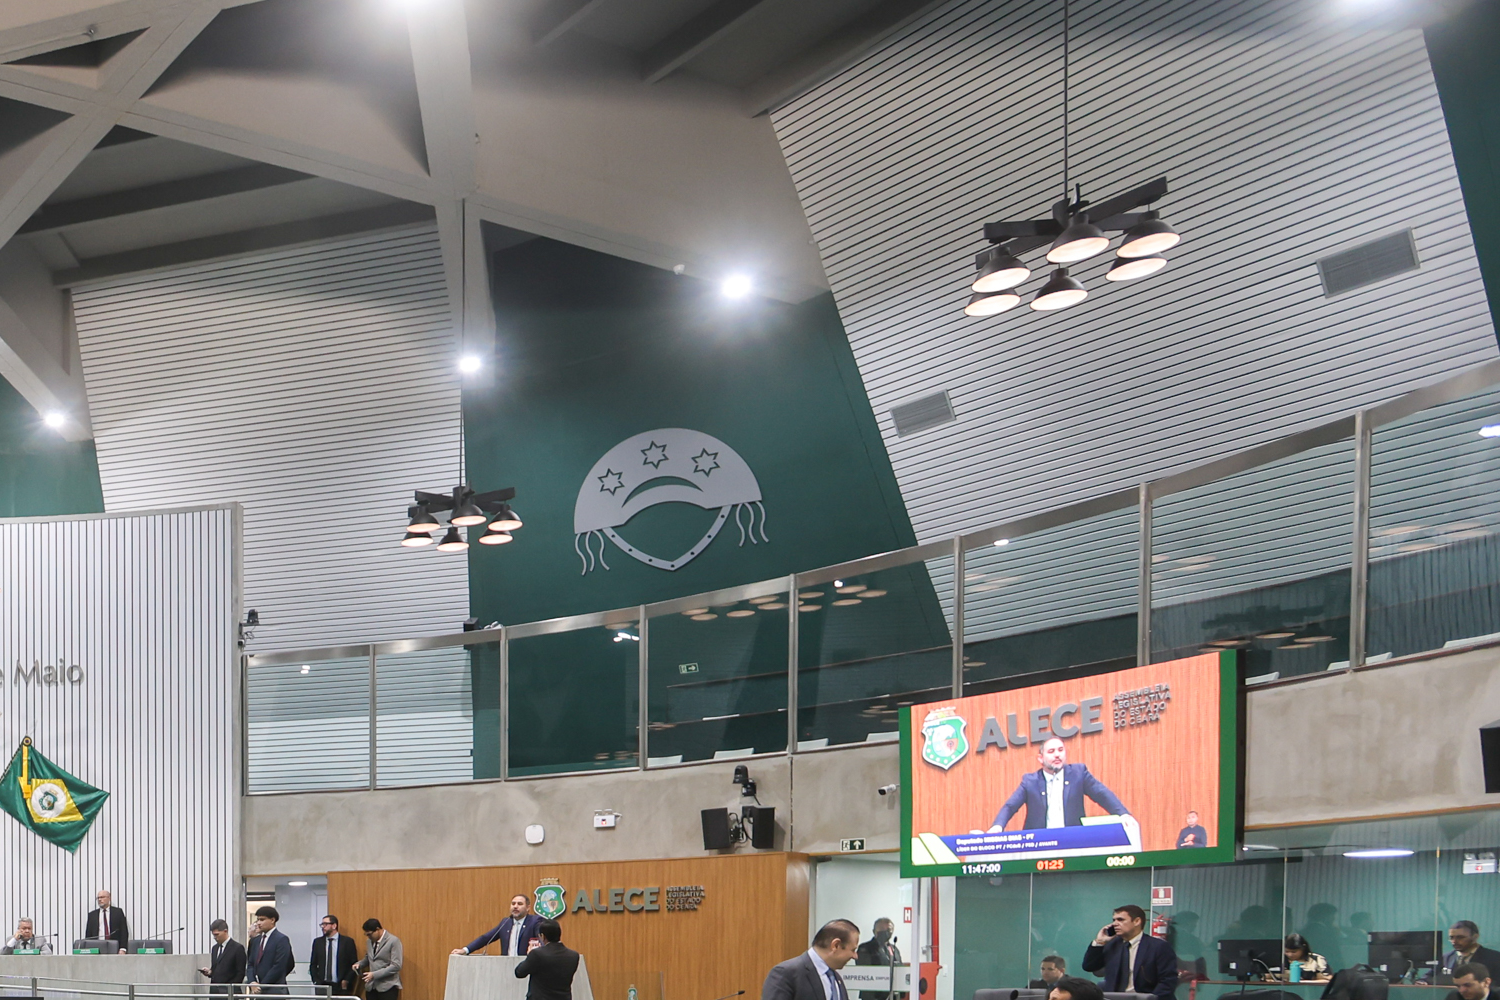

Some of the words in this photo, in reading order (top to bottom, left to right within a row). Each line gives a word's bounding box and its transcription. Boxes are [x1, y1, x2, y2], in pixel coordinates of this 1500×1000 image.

[14, 658, 85, 687] Maio
[1113, 683, 1170, 700] ASSEMBLEIA
[1113, 691, 1171, 710] LEGISLATIVA
[1114, 709, 1126, 719] DO
[1129, 701, 1166, 717] ESTADO
[976, 696, 1104, 753] ALECE
[1114, 718, 1126, 729] DO
[962, 864, 1001, 874] 11:47:00
[1037, 860, 1064, 870] 01:25
[1106, 855, 1135, 867] 00:00
[571, 887, 661, 914] ALECE
[904, 910, 911, 921] H
